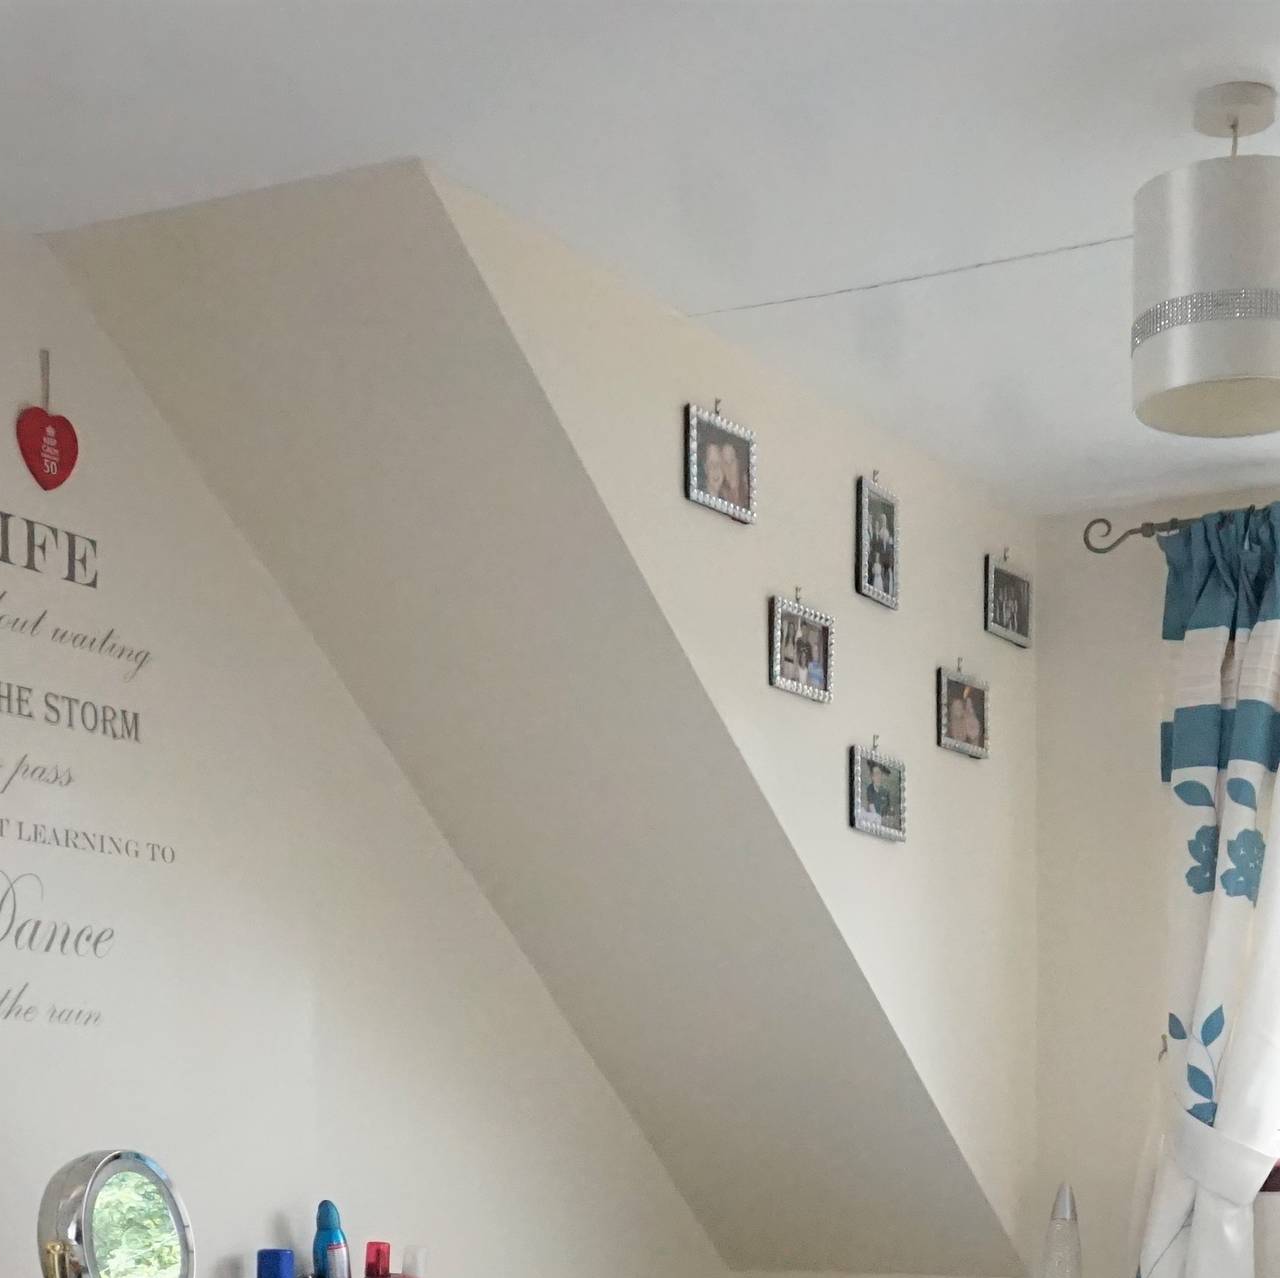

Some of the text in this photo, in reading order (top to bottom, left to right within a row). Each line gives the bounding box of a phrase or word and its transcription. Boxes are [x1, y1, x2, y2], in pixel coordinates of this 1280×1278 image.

[42, 459, 58, 475] 50
[50, 628, 152, 683] waiting
[43, 691, 142, 744] STORM
[0, 753, 74, 794] pass
[17, 820, 140, 859] LEARNING
[146, 843, 177, 865] TO
[45, 1003, 104, 1027] rain
